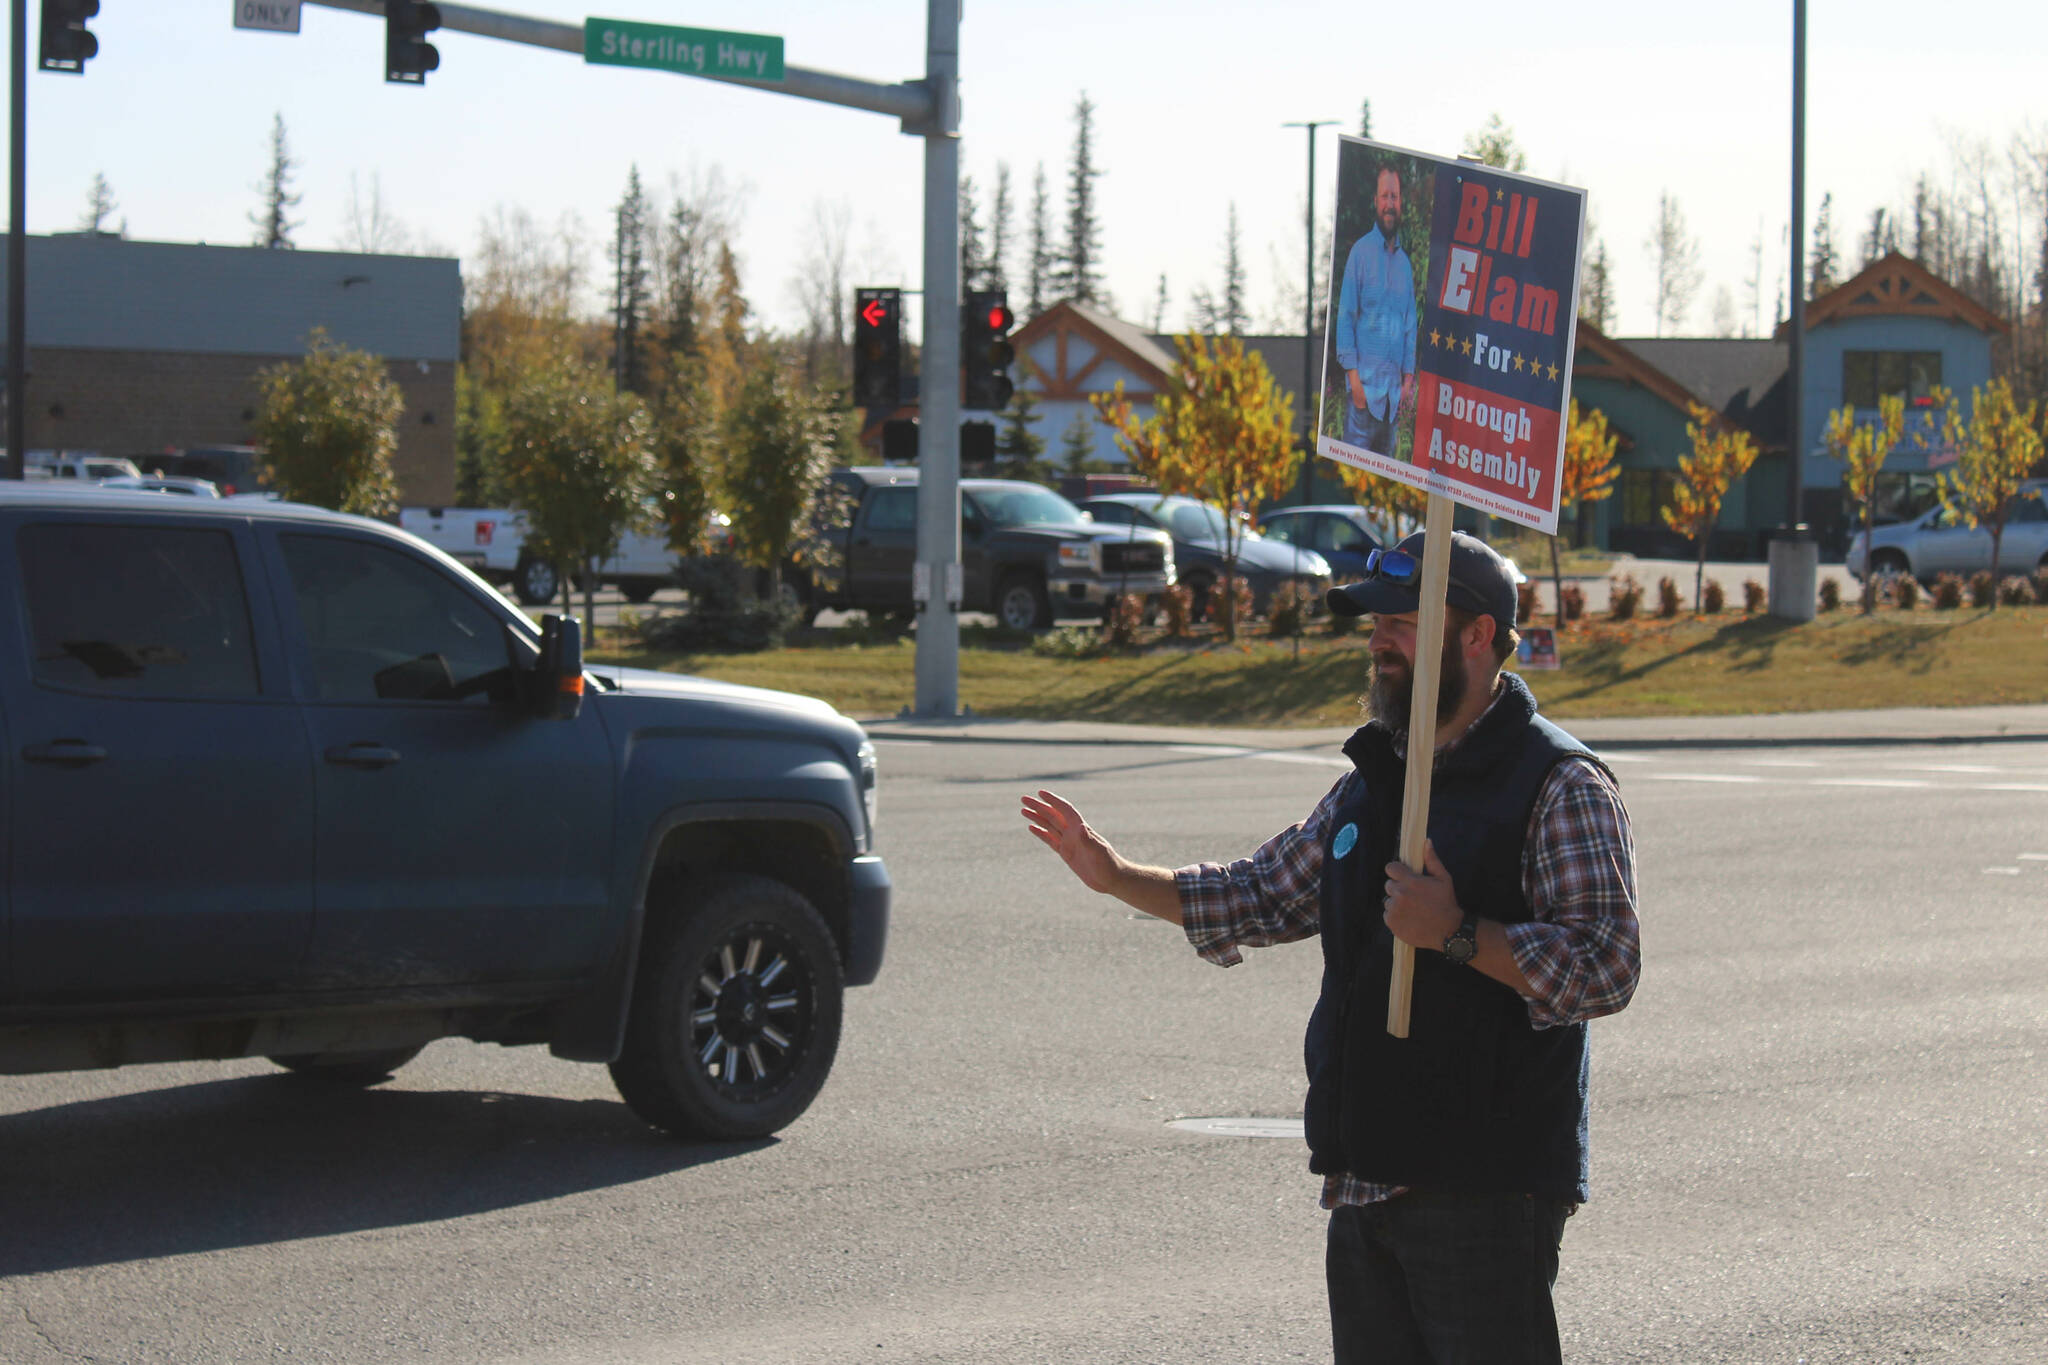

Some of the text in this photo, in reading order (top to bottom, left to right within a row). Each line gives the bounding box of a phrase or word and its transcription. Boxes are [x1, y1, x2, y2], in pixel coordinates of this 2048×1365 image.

[243, 2, 291, 24] ONLY
[602, 30, 767, 76] Sterling Hwy
[1453, 181, 1539, 258] Bill
[1440, 244, 1559, 336] Elam
[1473, 333, 1512, 373] For
[1437, 382, 1531, 444] Borough
[1428, 427, 1541, 500] Assembly
